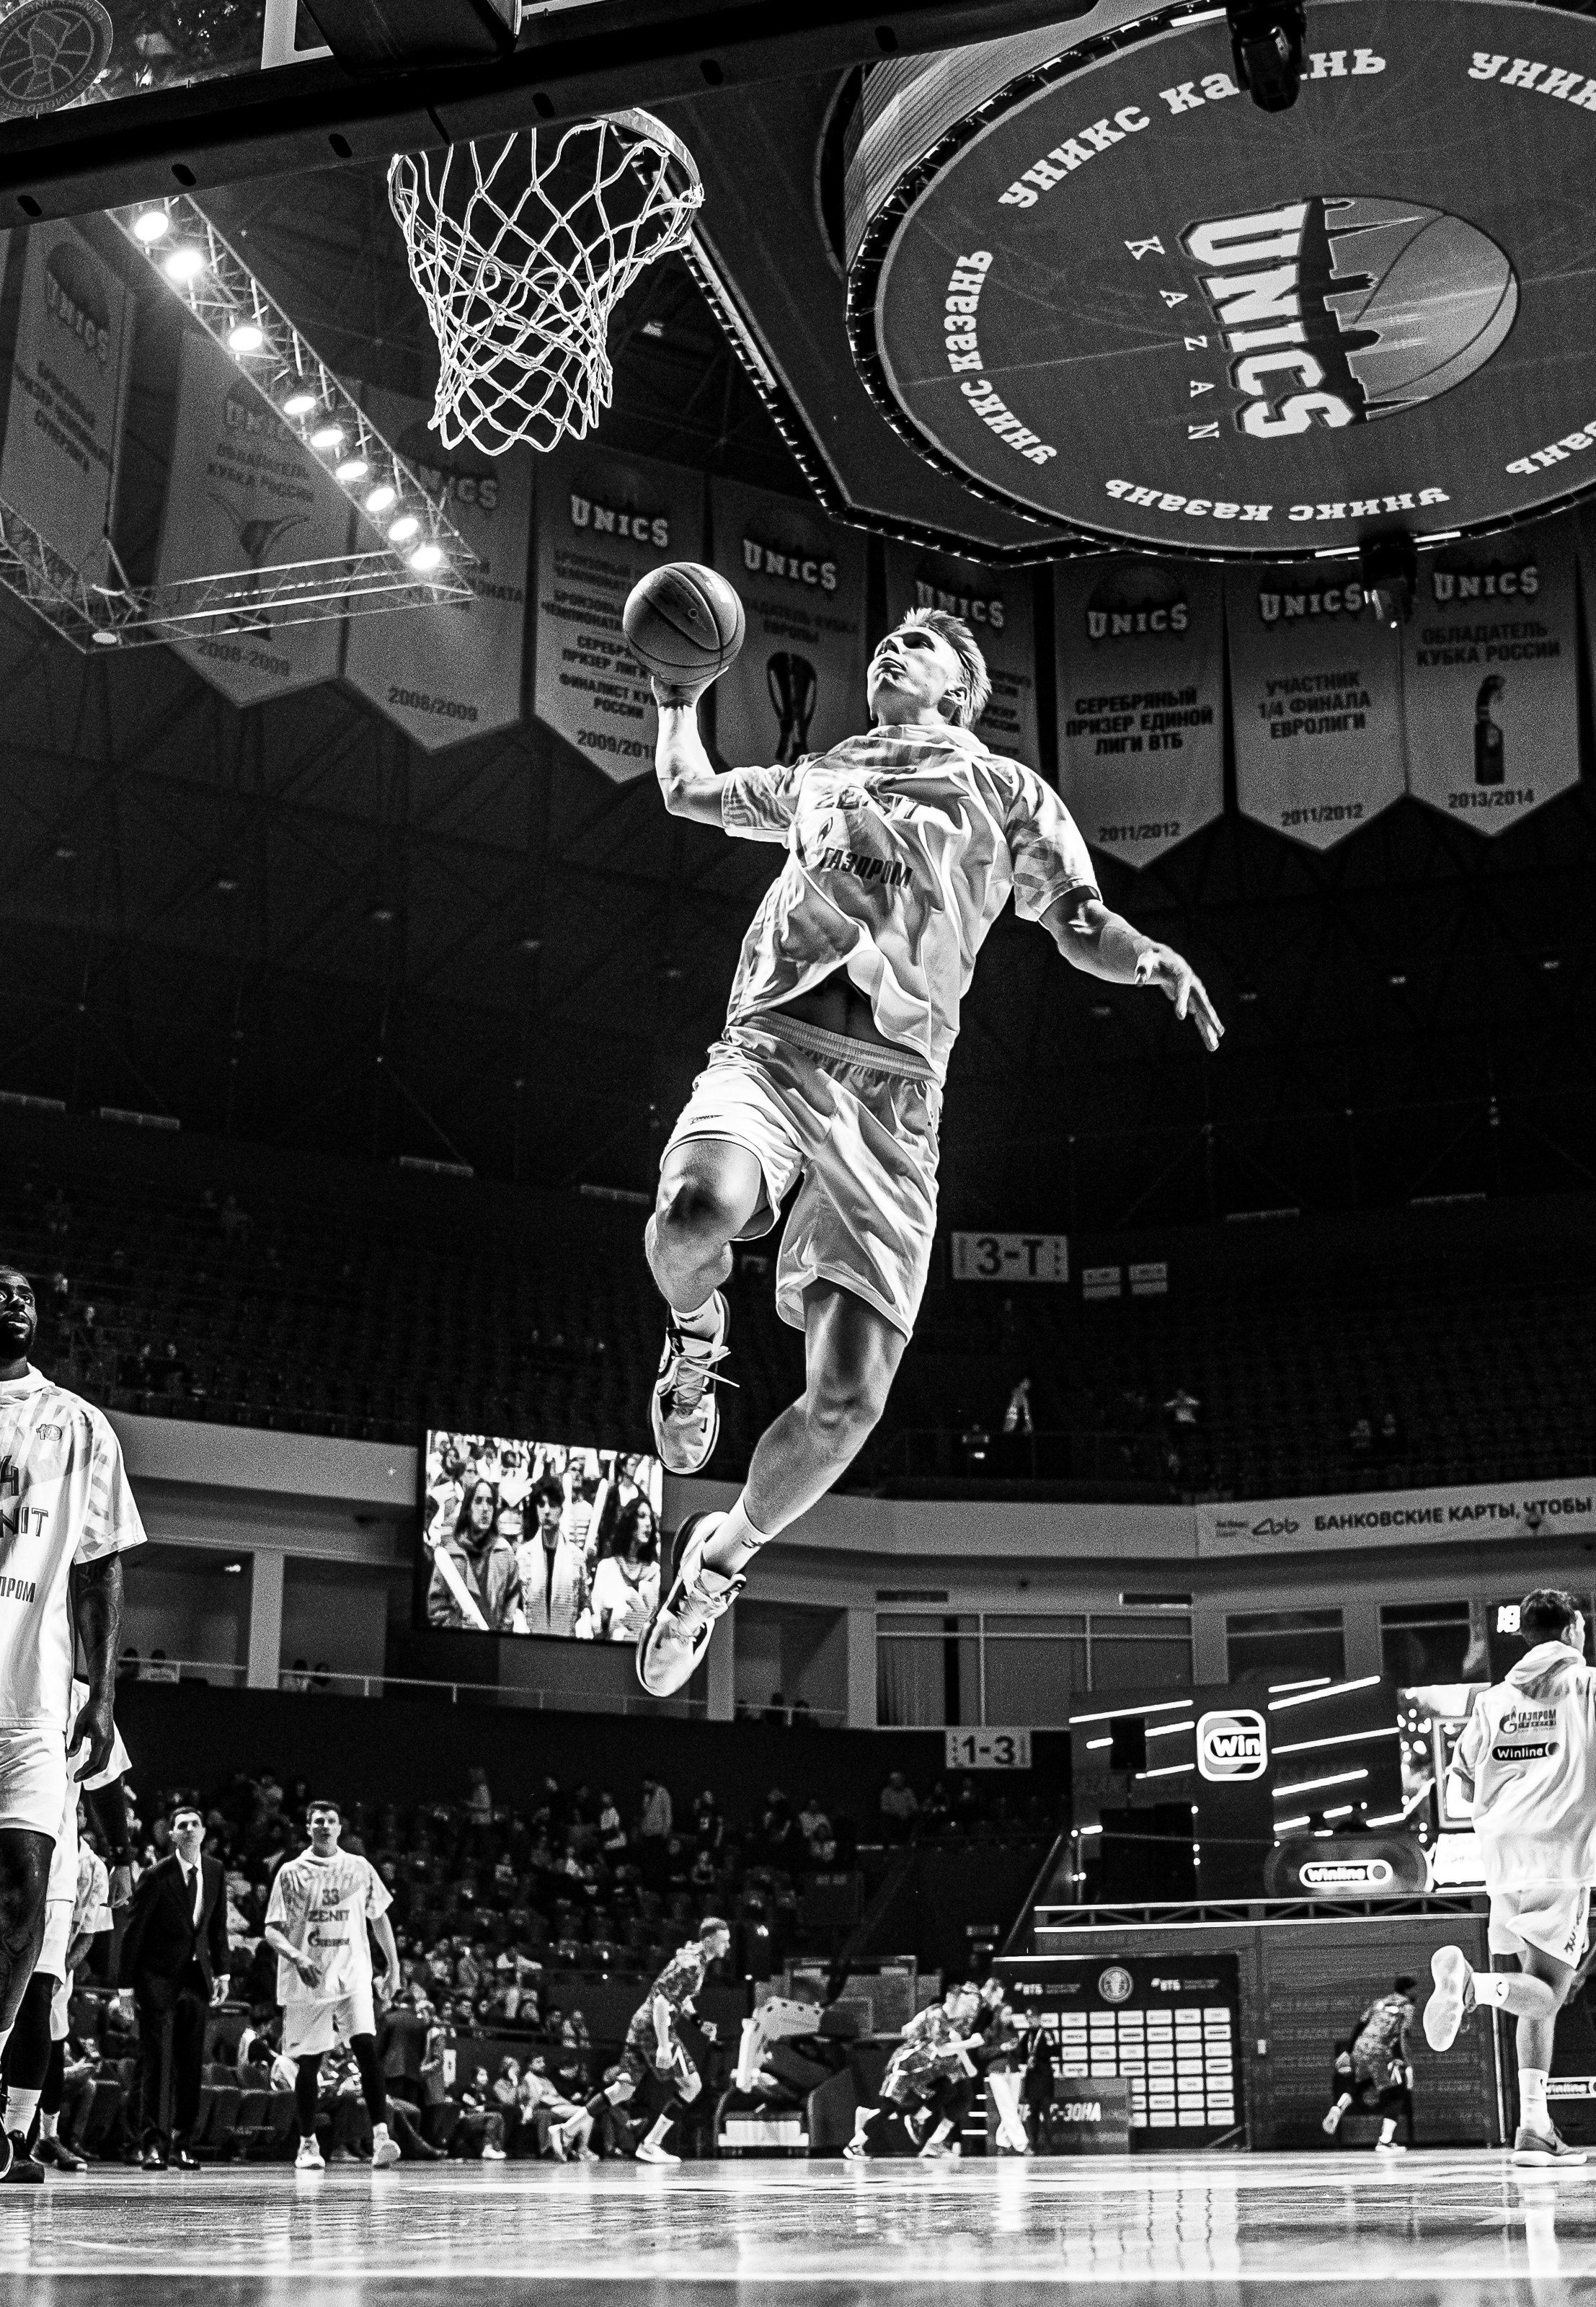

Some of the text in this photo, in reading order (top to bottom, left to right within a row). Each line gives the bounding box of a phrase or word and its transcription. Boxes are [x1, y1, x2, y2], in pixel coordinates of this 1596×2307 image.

[1184, 201, 1355, 439] UNICS
[570, 495, 668, 548] UNICS
[742, 539, 837, 591] UNICS
[1434, 565, 1539, 601] UNICS
[1259, 583, 1363, 621] UNICS
[1088, 603, 1189, 639] UNICS
[1075, 686, 1197, 714] СЕРЕБРЯНЫЙ
[1265, 672, 1360, 697] УЧАСТНИК
[1289, 691, 1371, 714] ФИНАЛА
[1065, 714, 1134, 736] ПРИЗЕР
[1095, 732, 1184, 756] ЛИГИ ВТБ
[819, 847, 913, 889] ГАЗПРОМ
[1313, 1502, 1442, 1531] БАНКОВСКИЕ
[1523, 1497, 1592, 1515] ЧТОБЫ
[962, 1735, 1015, 1764] 1-3
